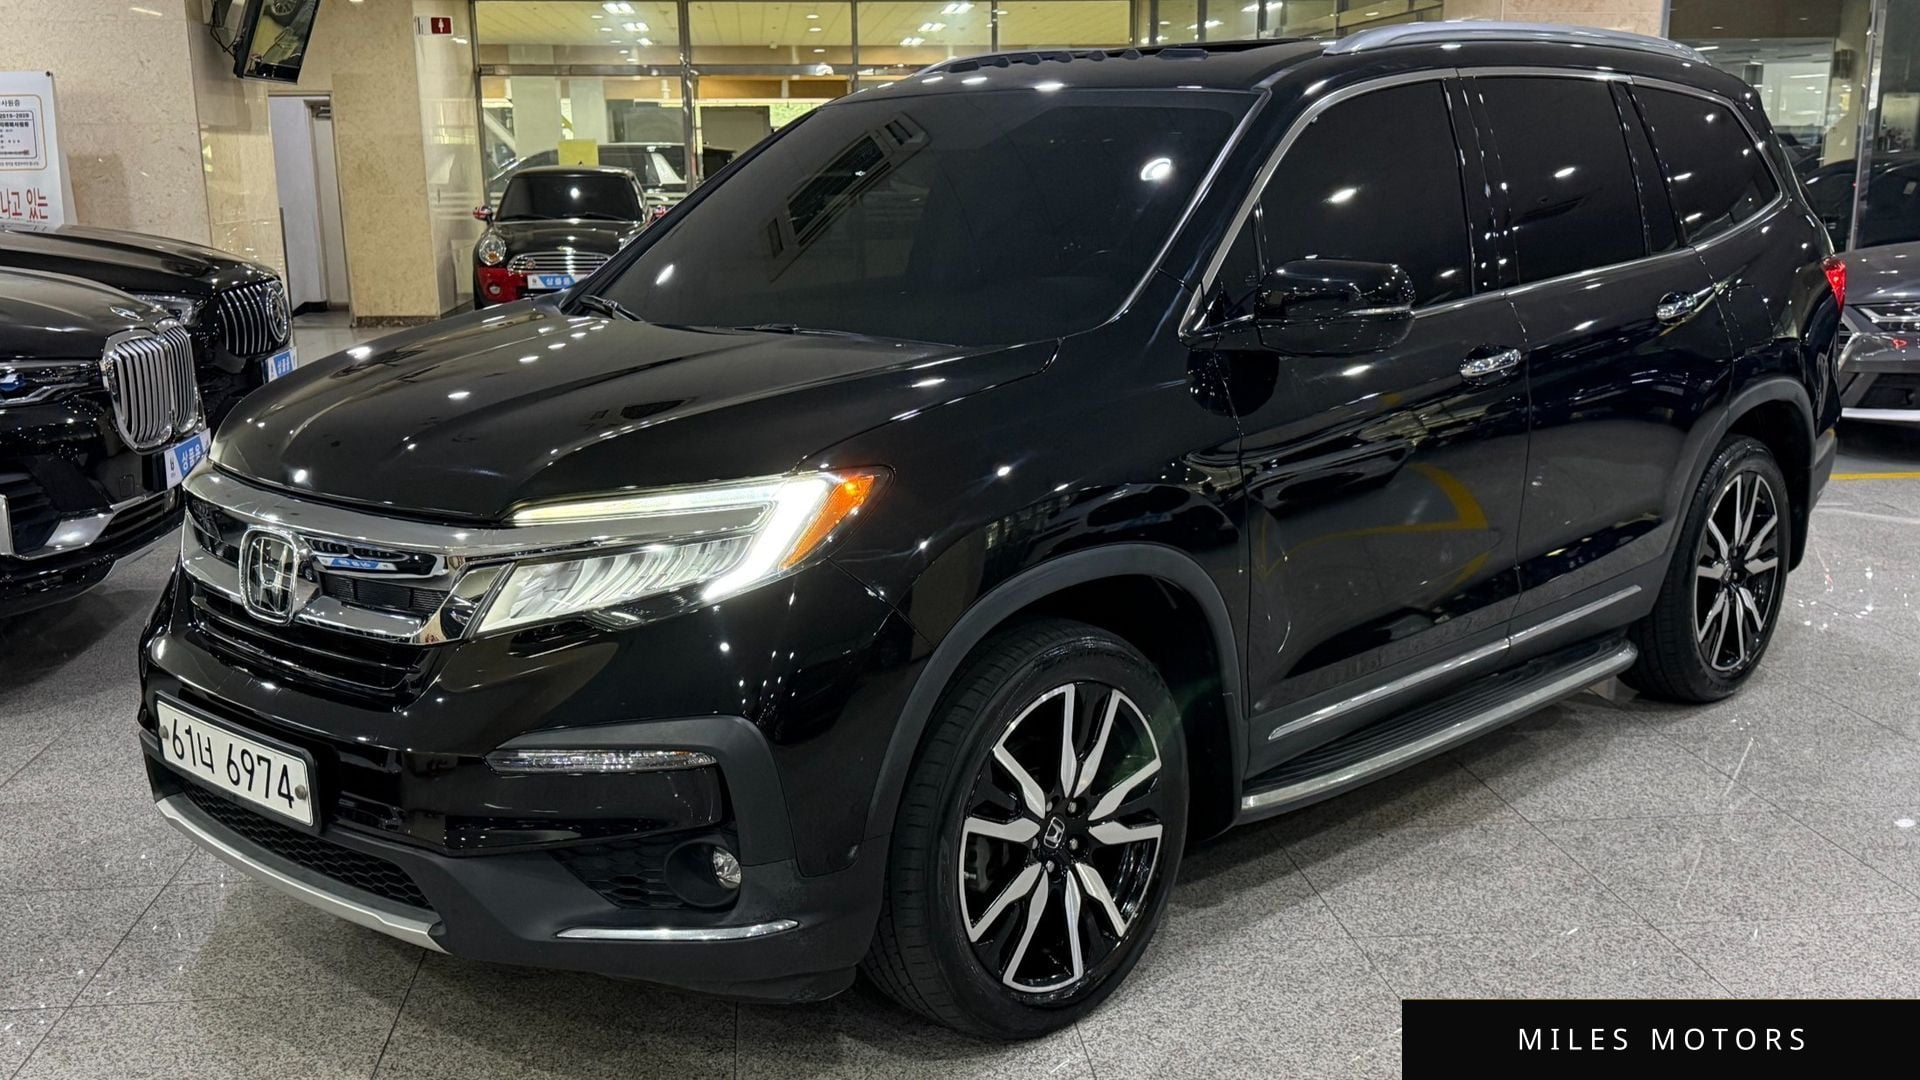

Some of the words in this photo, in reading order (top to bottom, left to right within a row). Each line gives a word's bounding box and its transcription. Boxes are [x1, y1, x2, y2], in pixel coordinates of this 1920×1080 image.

[26, 186, 48, 219] 있는
[172, 718, 215, 774] 61너
[226, 743, 295, 809] 6974
